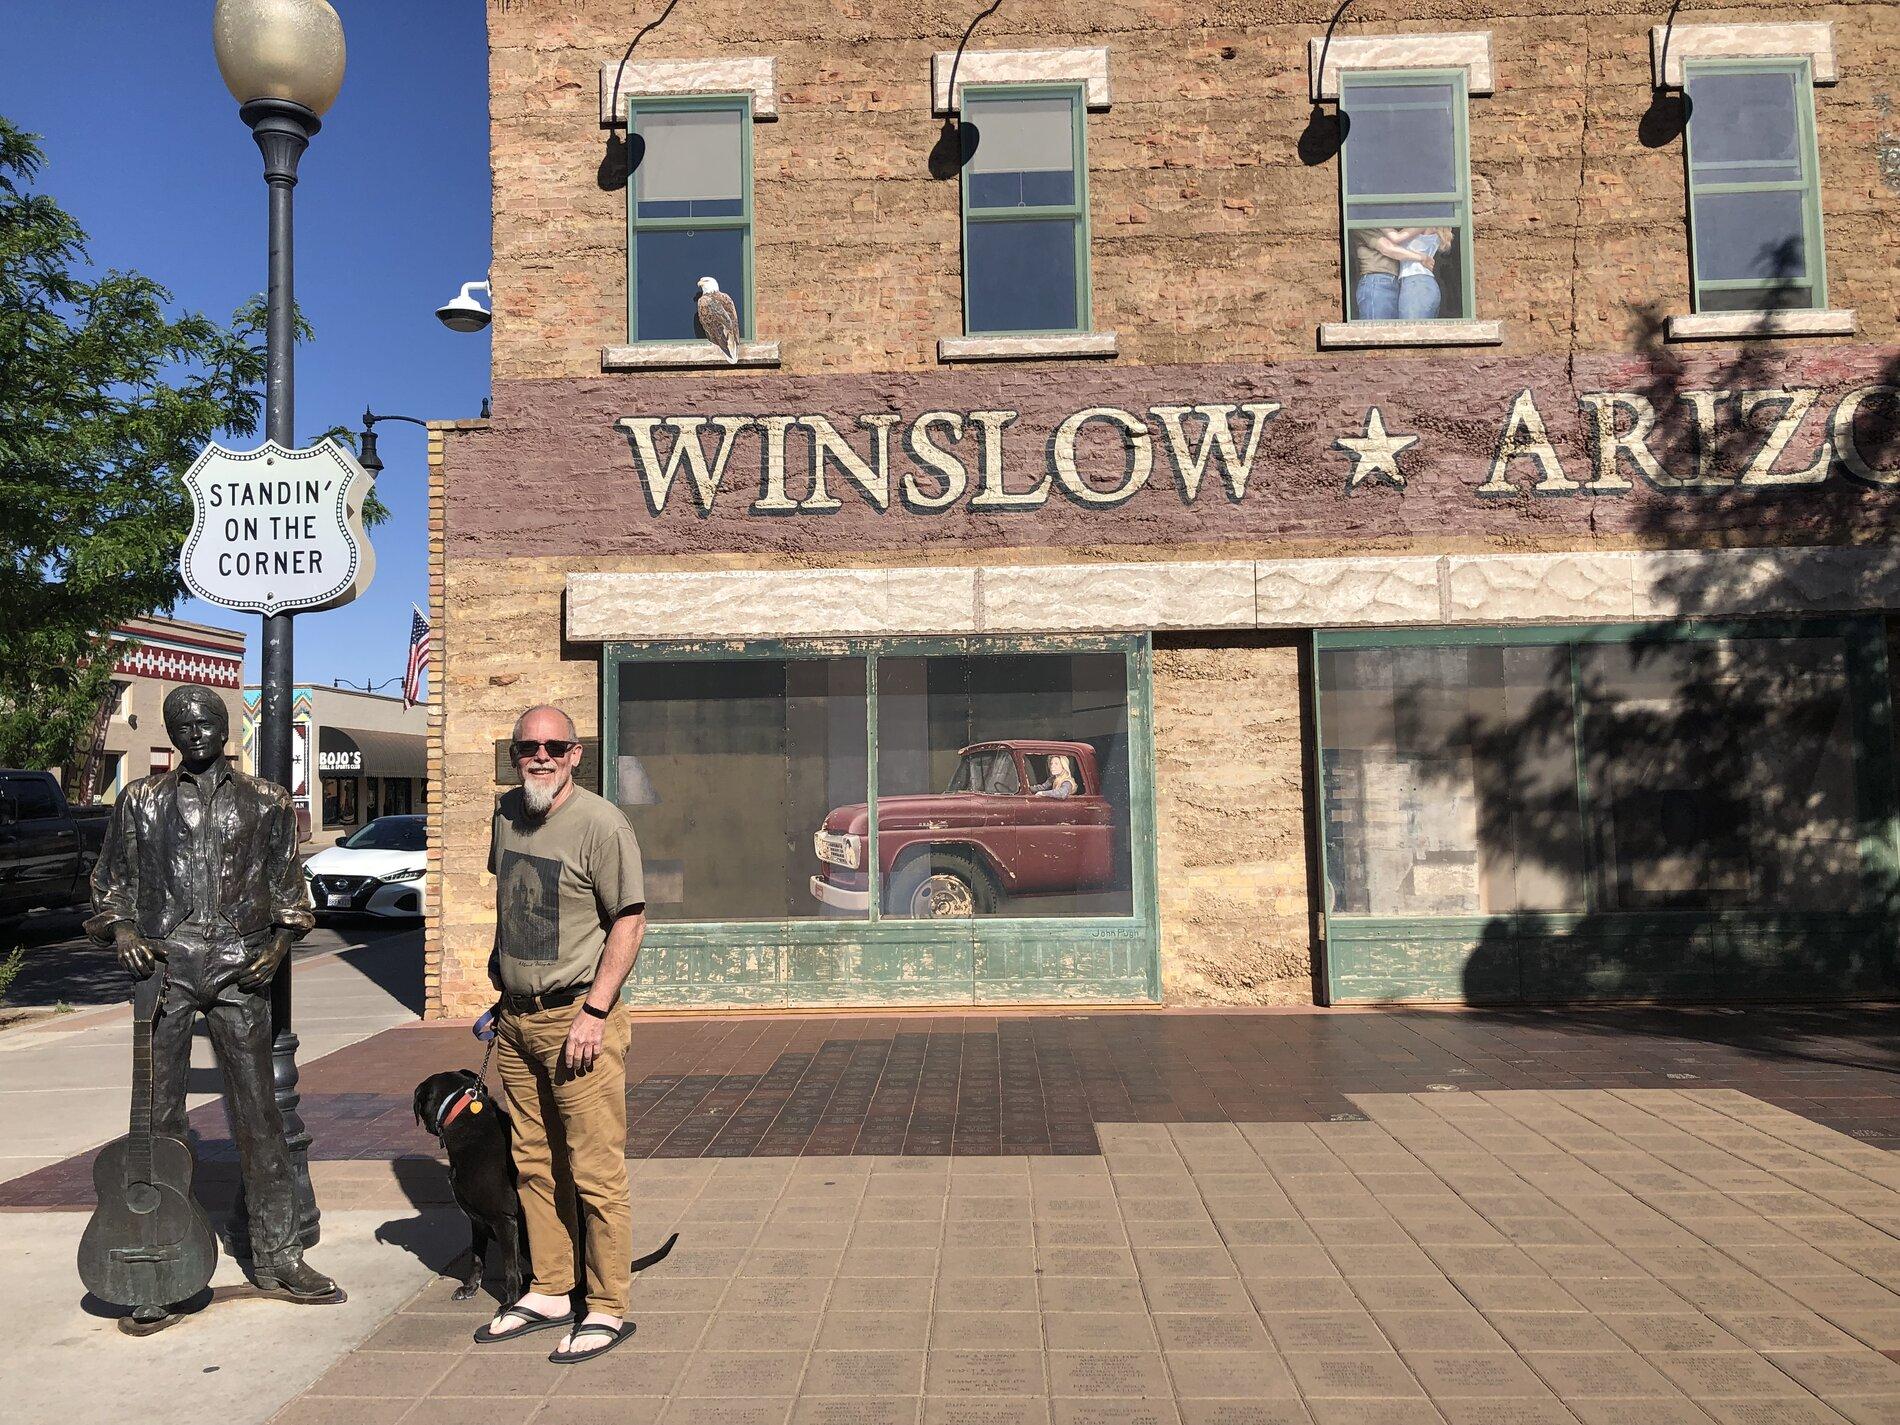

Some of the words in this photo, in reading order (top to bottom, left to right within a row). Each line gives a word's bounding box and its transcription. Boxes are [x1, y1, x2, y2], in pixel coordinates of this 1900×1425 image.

[616, 402, 1281, 512] WINSLOW
[210, 481, 332, 507] STANDIN'
[225, 517, 258, 542] ON
[270, 515, 317, 540] THE
[218, 550, 322, 576] CORNER
[319, 751, 361, 765] BOJO'S
[1092, 929, 1116, 938] John
[1117, 928, 1139, 939] Pugh
